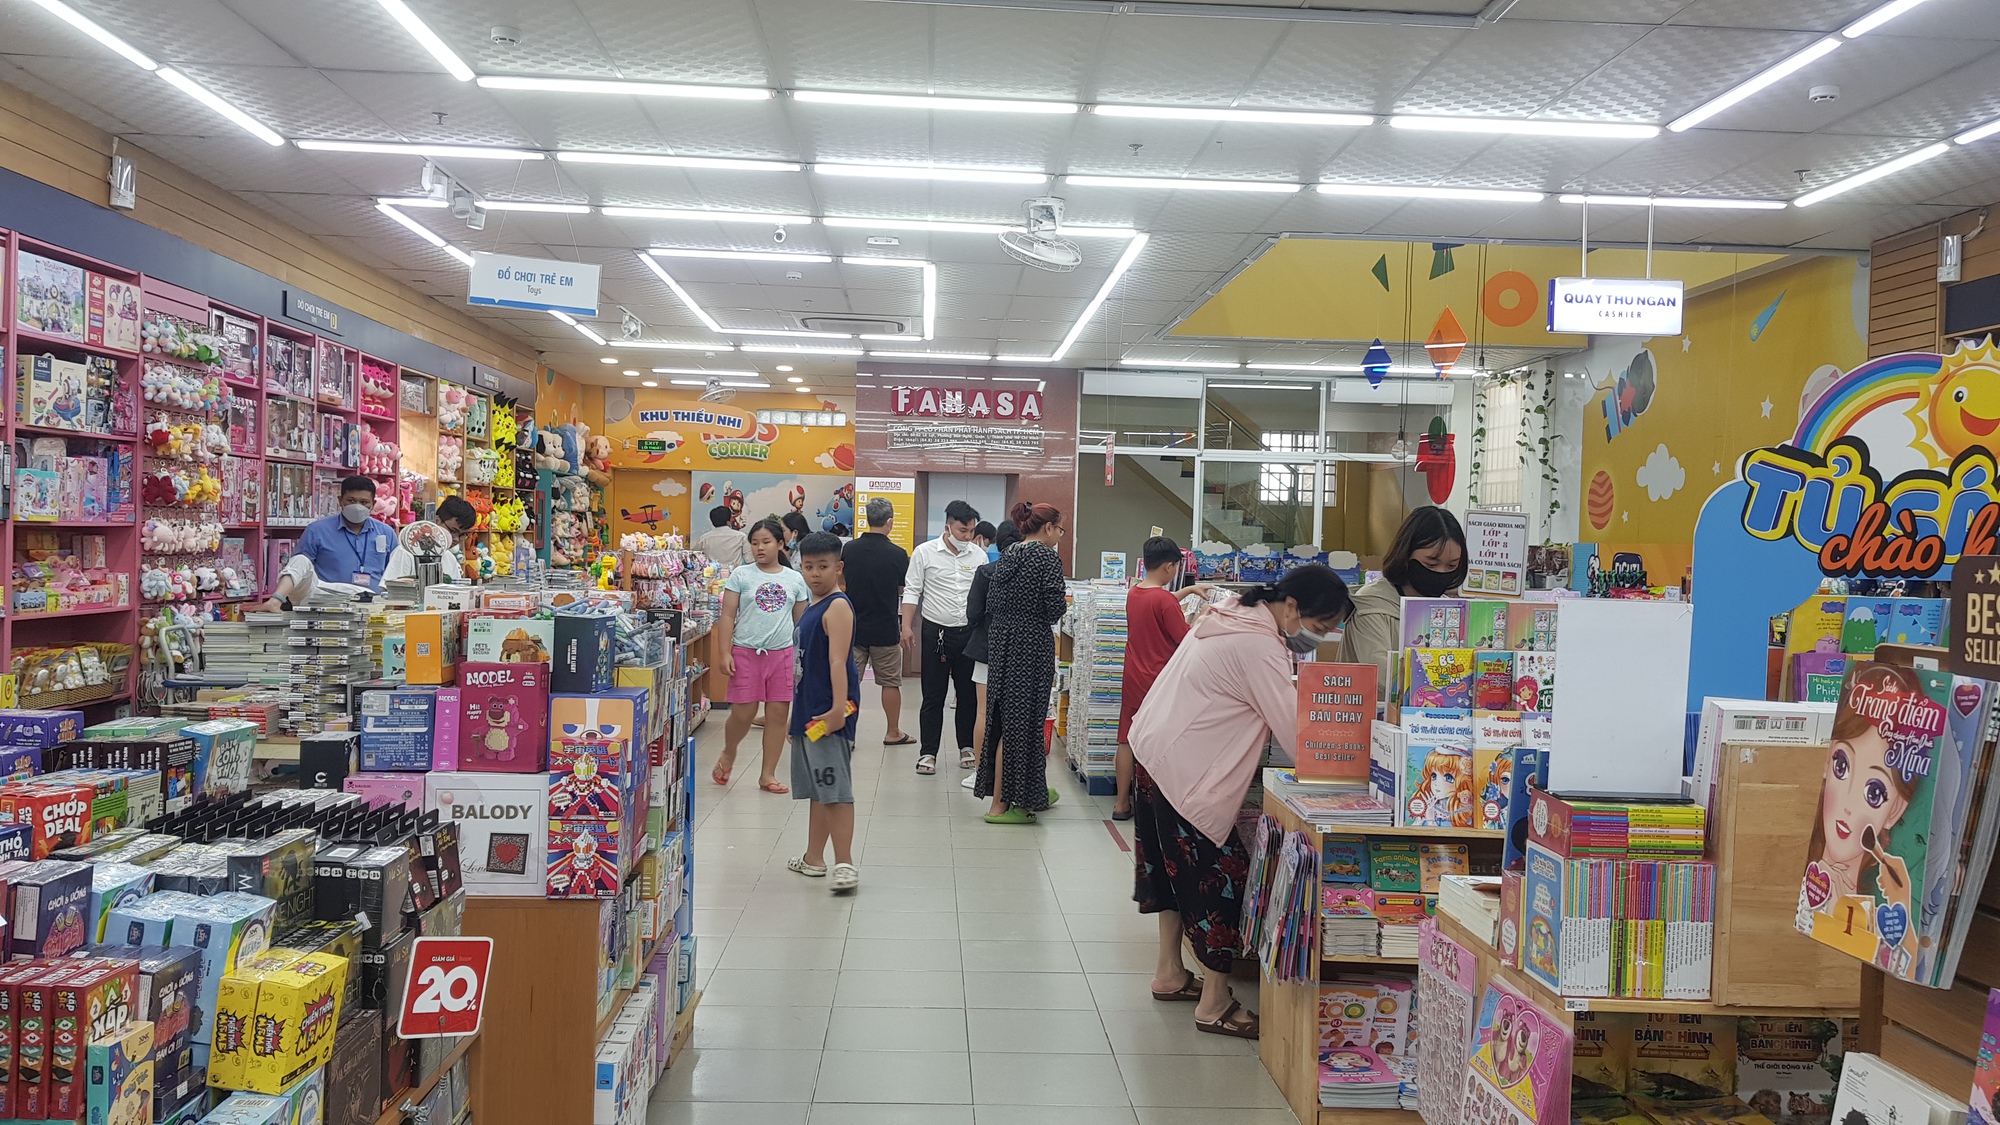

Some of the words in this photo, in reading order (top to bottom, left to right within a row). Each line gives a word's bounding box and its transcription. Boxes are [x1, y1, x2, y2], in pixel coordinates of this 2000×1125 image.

[560, 276, 574, 286] EM
[527, 285, 542, 296] Toys
[897, 389, 1040, 416] FAHASA
[640, 411, 669, 422] KHU
[672, 408, 714, 423] THIẾU
[717, 415, 742, 428] NHI
[708, 443, 770, 459] CORNER
[1483, 528, 1500, 537] LỚP
[1821, 502, 1944, 572] chào
[1482, 538, 1500, 548] LỚP
[1480, 550, 1497, 558] LỚP
[466, 670, 515, 686] MODEL
[1324, 674, 1352, 687] SÁCH
[1312, 690, 1340, 705] THIẾU
[1344, 694, 1362, 705] NHI
[1850, 684, 1900, 733] Trang
[1898, 692, 1939, 732] điểm
[1310, 709, 1332, 722] BÁN
[1336, 712, 1363, 726] CHẠY
[1305, 740, 1343, 750] Children's
[1344, 742, 1366, 750] Books
[1315, 752, 1330, 760] Best
[1333, 752, 1355, 761] Seller
[1886, 742, 1931, 781] Mina
[452, 804, 533, 820] BALODY
[44, 817, 82, 838] DEAL
[1374, 854, 1392, 864] Farm
[1393, 854, 1418, 866] animals
[412, 966, 478, 1014] 20%
[1678, 1028, 1712, 1044] HÌNH
[1784, 1038, 1811, 1050] HÌNH
